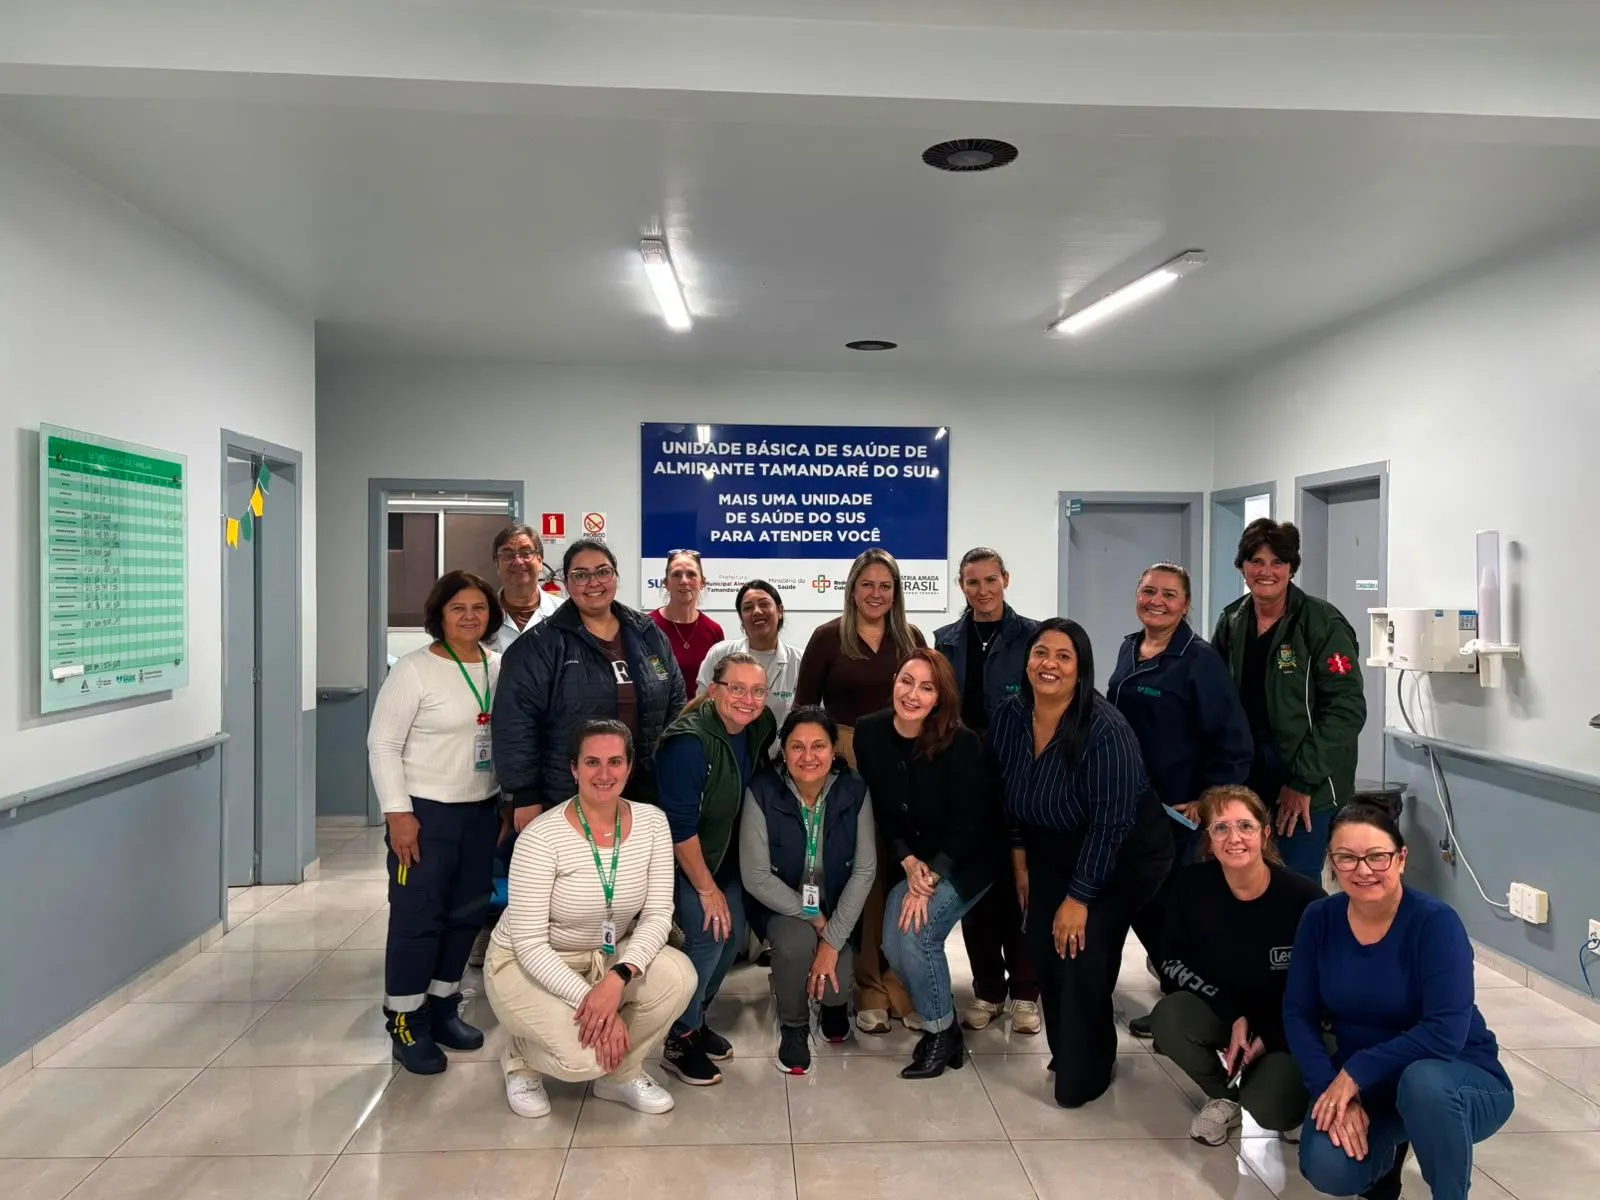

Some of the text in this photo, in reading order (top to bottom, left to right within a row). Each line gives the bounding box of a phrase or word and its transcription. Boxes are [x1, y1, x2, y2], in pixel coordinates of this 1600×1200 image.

[662, 439, 928, 458] UNIDADE BÁSICA DE SAÚDE DE
[653, 461, 935, 479] ALMIRANTE TAMANDARÉ DO SUL
[718, 494, 873, 506] MAIS UMA UNIDADE
[725, 509, 866, 524] DE SAÚDE DO SUS
[710, 527, 881, 542] PARA ATENDER VOCÊ
[647, 578, 664, 589] SU
[903, 581, 939, 591] RASIL
